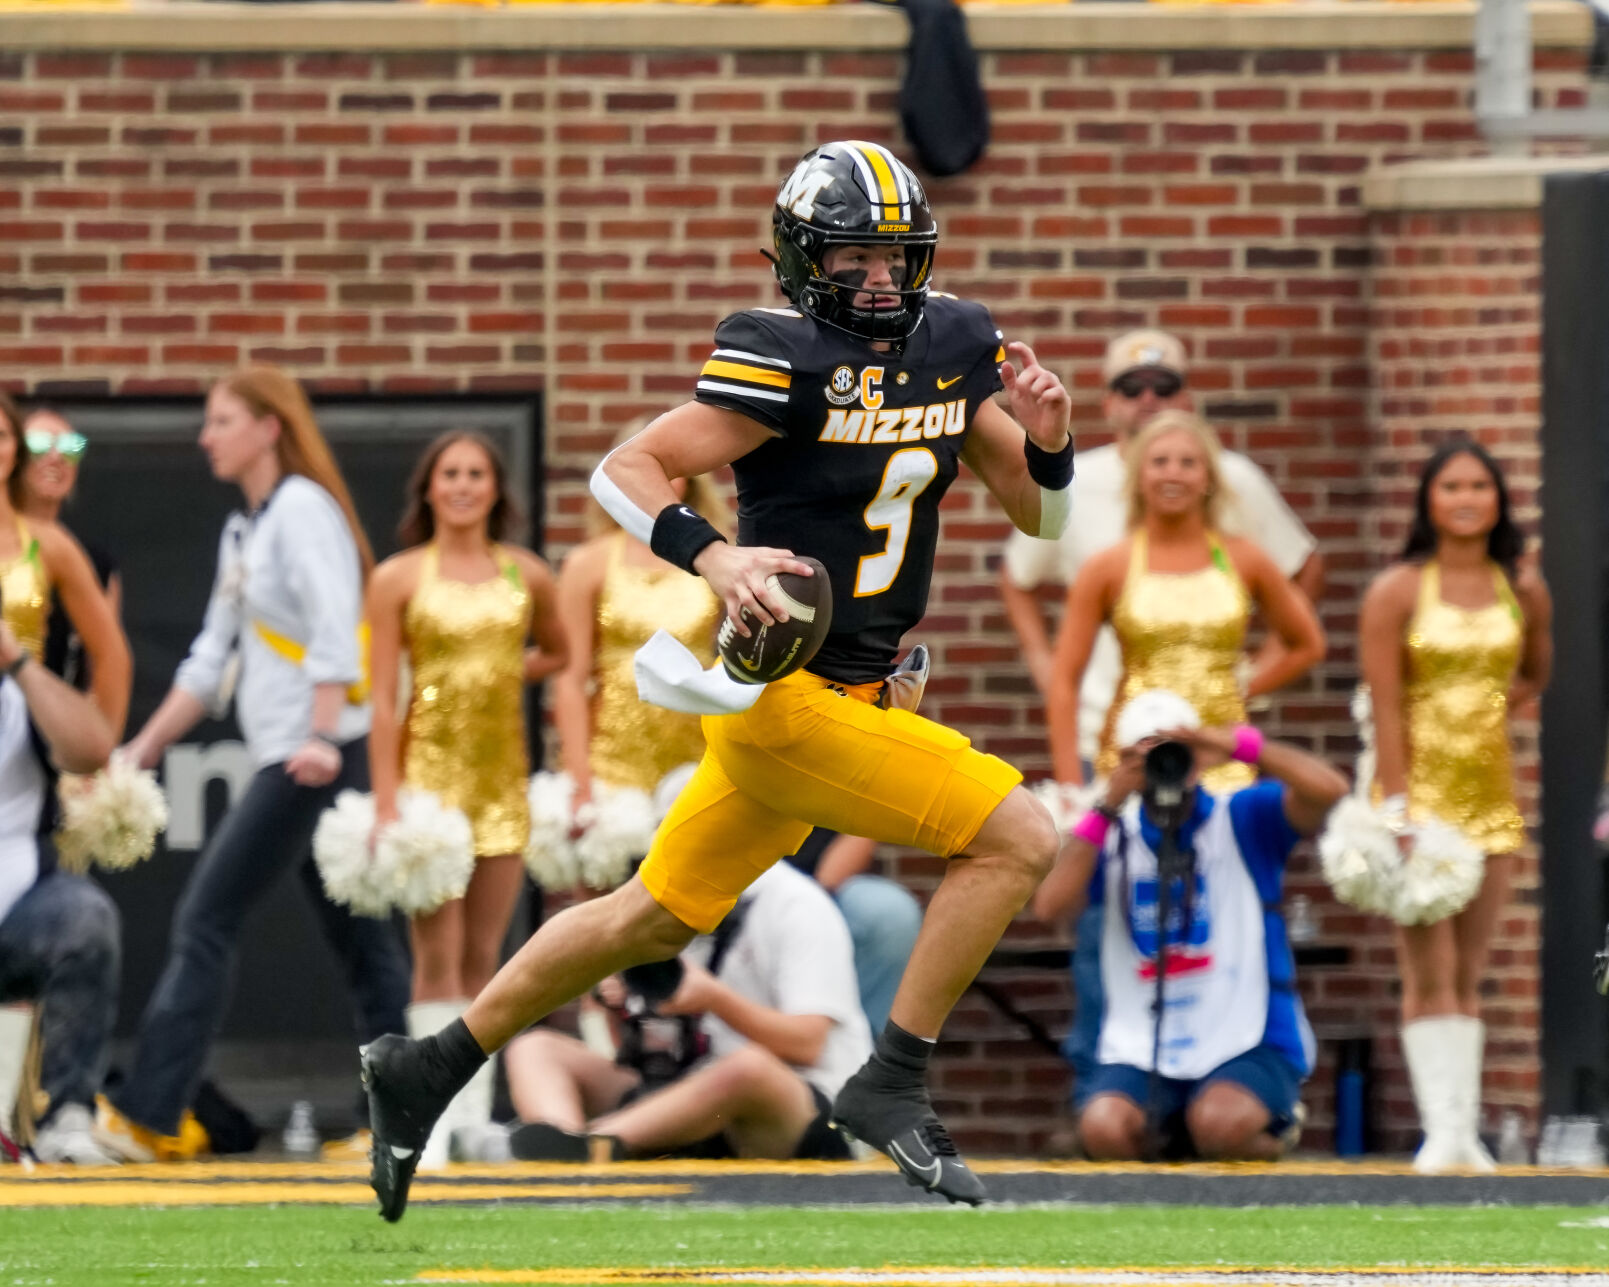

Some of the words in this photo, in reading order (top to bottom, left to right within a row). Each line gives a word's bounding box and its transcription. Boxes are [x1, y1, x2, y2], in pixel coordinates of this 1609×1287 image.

[777, 160, 836, 222] M
[877, 224, 910, 232] MIZZOU
[834, 368, 852, 391] SEC
[860, 366, 885, 410] C
[817, 398, 967, 444] MIZZOU
[853, 447, 938, 598] 9
